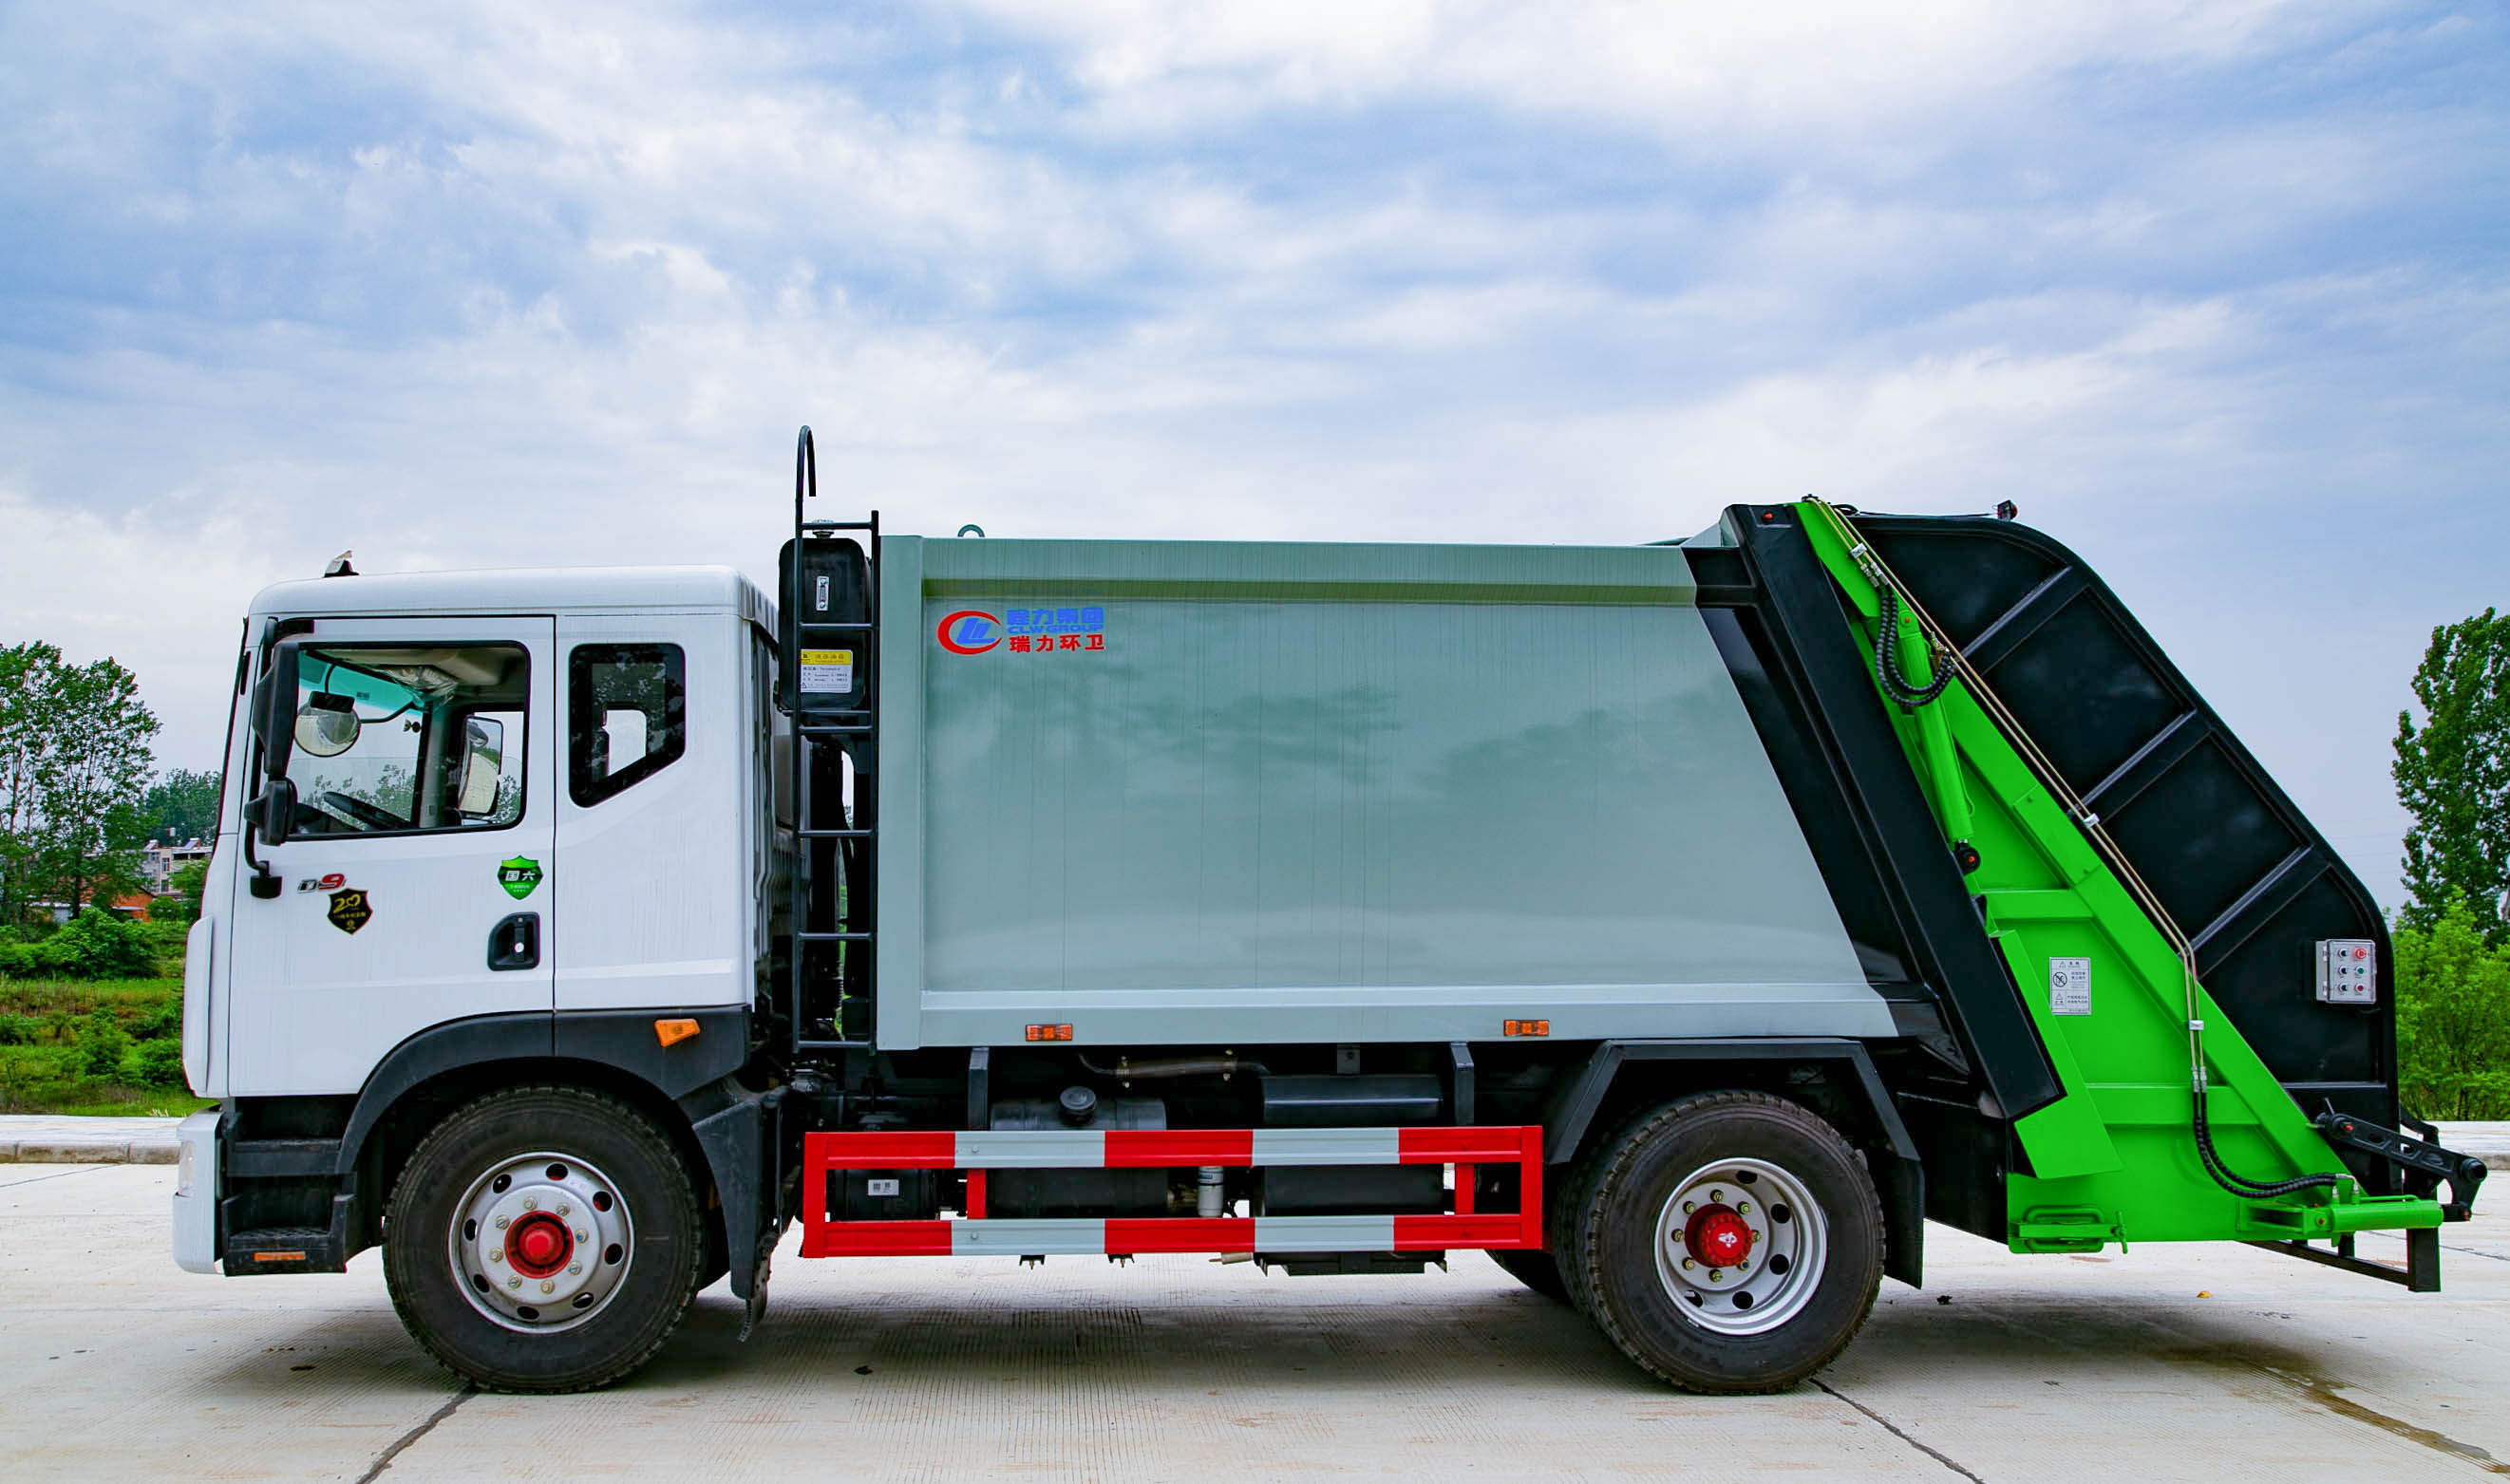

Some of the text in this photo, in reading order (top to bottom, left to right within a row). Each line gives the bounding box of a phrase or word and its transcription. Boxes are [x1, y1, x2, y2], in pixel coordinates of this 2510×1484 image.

[1009, 634, 1105, 652] 瑞力环卫
[298, 873, 347, 893] D9
[505, 871, 536, 881] 国六
